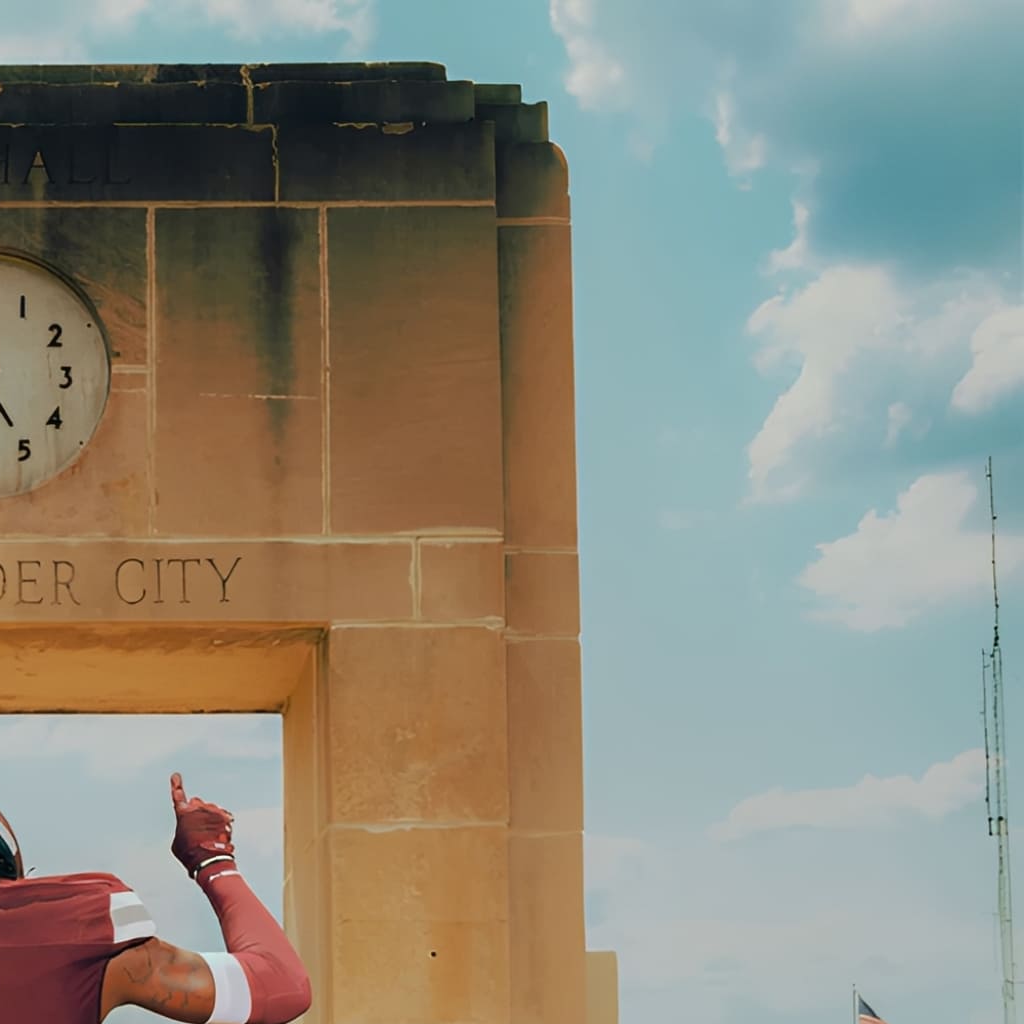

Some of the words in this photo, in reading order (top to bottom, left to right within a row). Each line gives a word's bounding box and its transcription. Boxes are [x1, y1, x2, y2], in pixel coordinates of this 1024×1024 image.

[20, 295, 26, 319] 1
[47, 323, 63, 348] 2
[59, 366, 73, 389] 3
[45, 406, 63, 430] 4
[18, 439, 31, 462] 5
[115, 557, 242, 605] CITY
